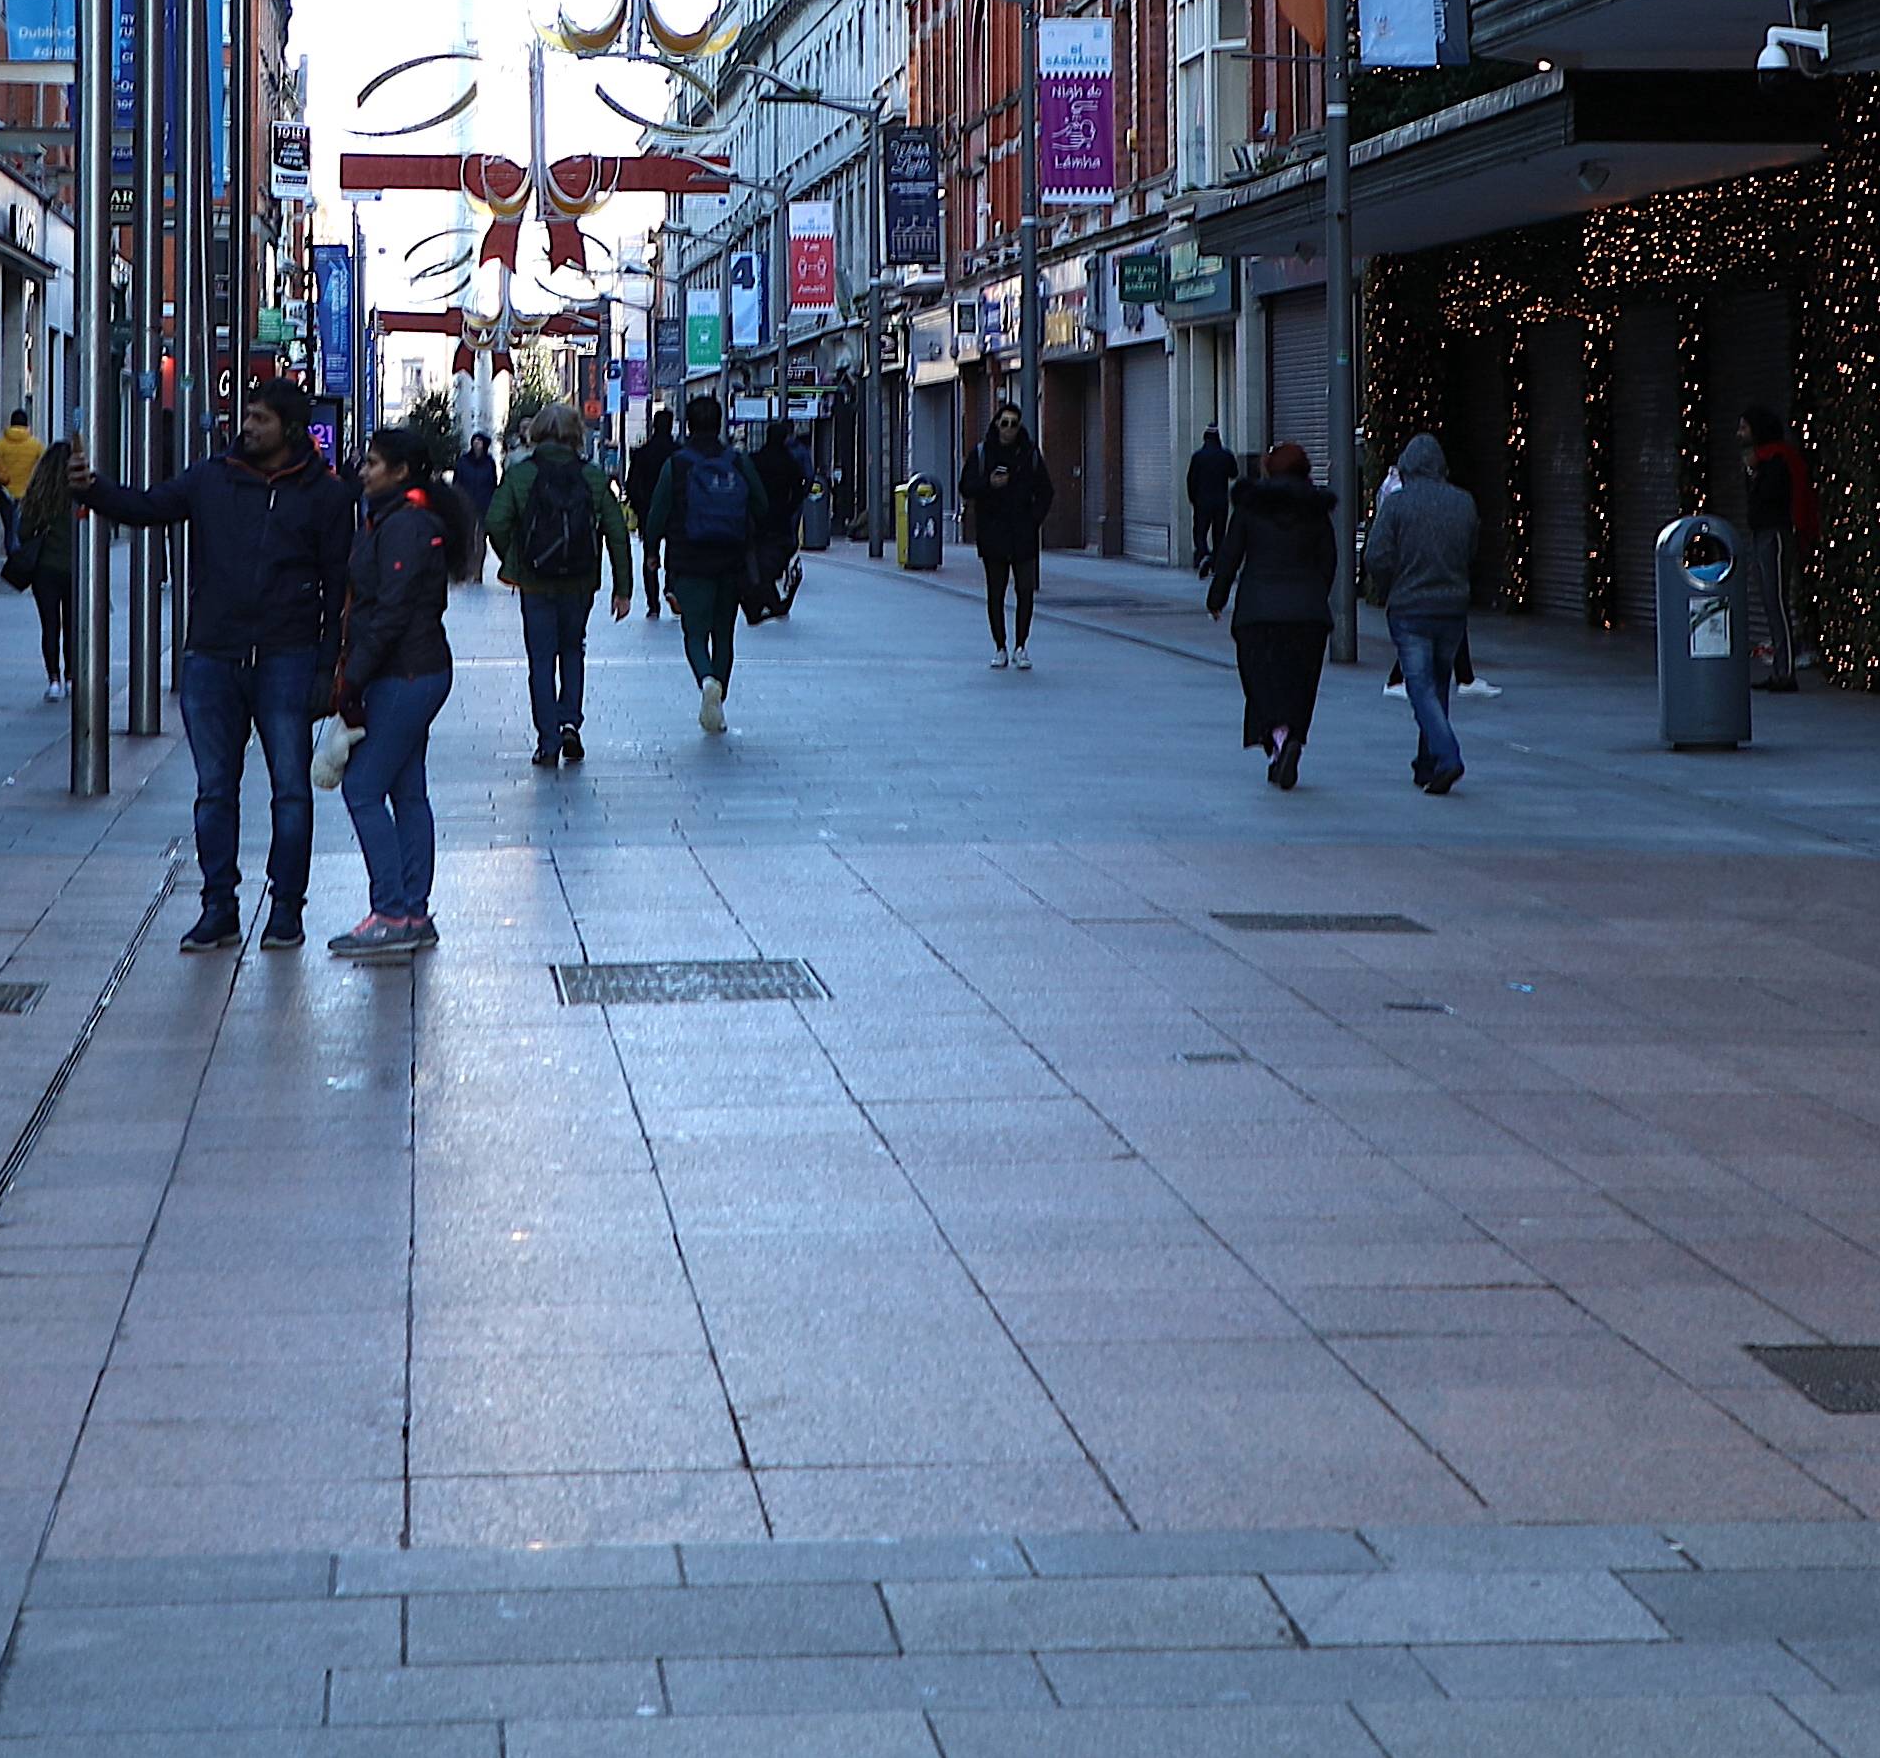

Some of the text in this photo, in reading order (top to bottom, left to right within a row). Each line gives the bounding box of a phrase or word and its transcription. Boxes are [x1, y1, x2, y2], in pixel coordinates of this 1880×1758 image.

[1051, 83, 1103, 103] Nigh do
[731, 255, 756, 290] 4
